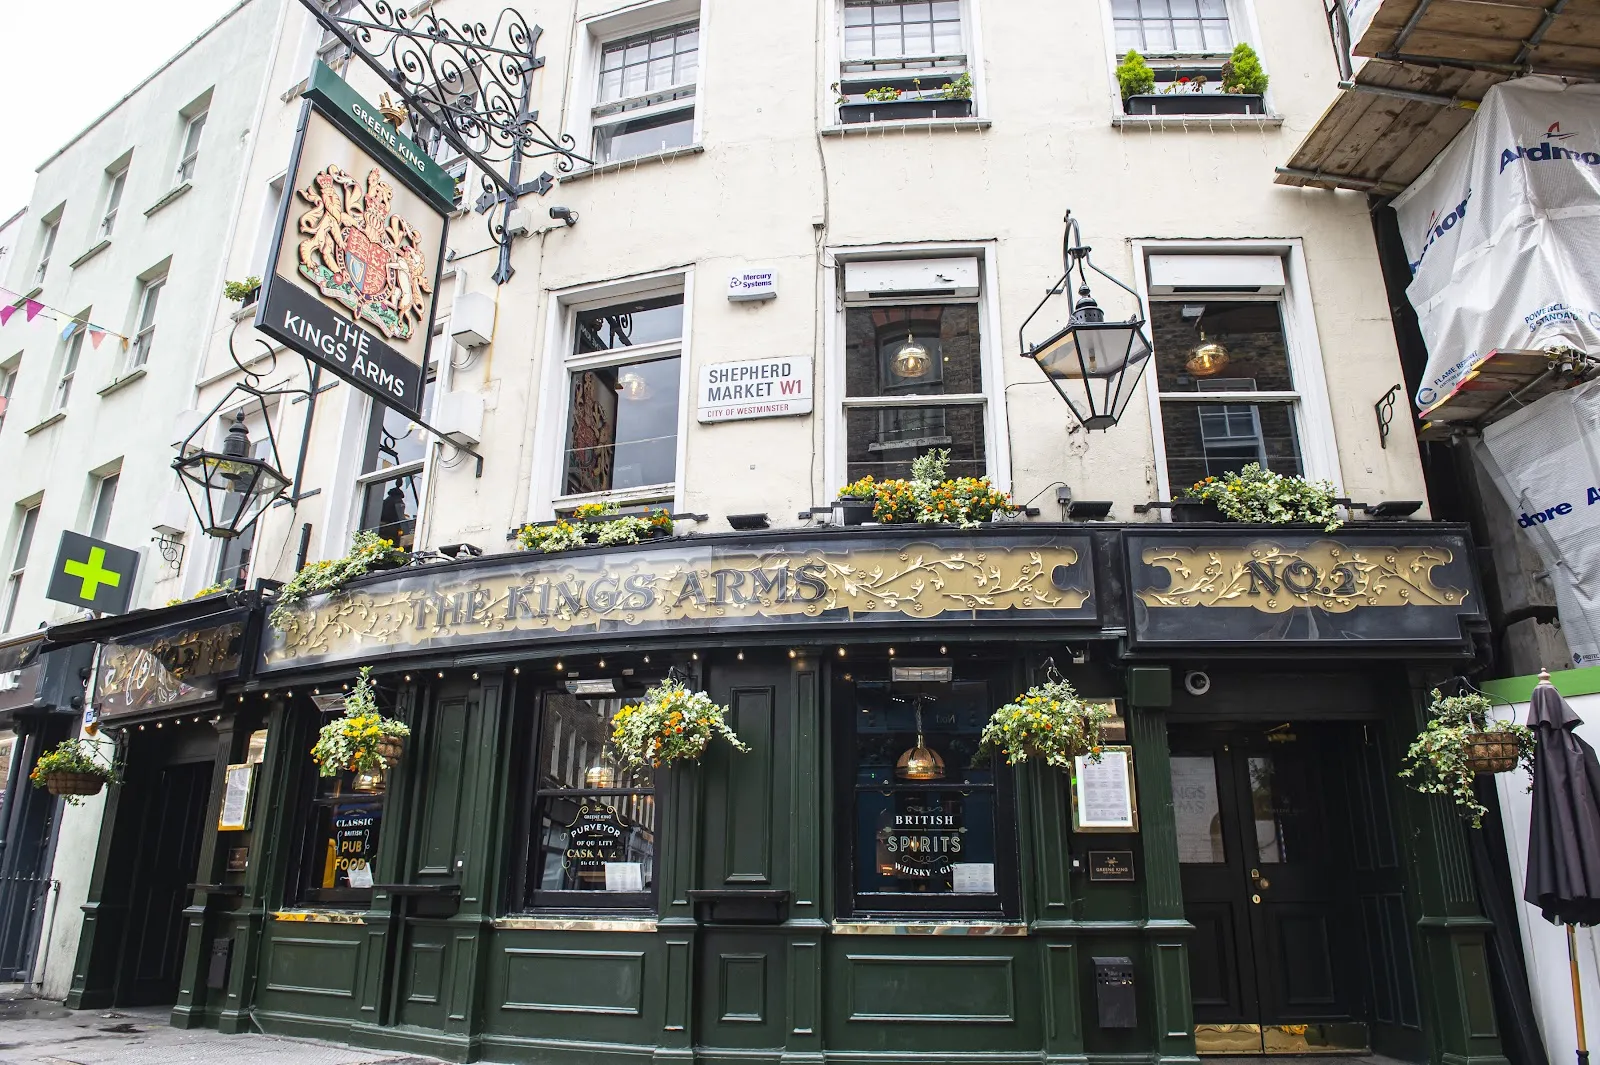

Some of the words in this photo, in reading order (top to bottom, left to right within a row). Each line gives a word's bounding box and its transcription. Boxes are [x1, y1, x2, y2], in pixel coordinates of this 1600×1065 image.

[352, 104, 396, 147] GREENE
[398, 142, 426, 172] KING
[743, 280, 772, 288] Systems
[333, 316, 371, 355] THE
[283, 310, 349, 363] KINGS
[351, 355, 405, 397] ARMS
[708, 362, 791, 384] SHEPHERD
[1433, 366, 1457, 386] FLAME
[708, 382, 774, 401] MARKET
[780, 379, 801, 395] W1
[707, 410, 723, 418] CITY
[726, 408, 735, 416] OF
[737, 404, 789, 415] WESTMINSTER
[411, 587, 491, 630] THE
[507, 573, 656, 621] KINGS
[673, 564, 827, 608] ARMS
[336, 818, 373, 828] CLASSIC
[895, 815, 953, 825] BRITISH
[570, 823, 621, 838] PURVEYOR
[341, 840, 362, 853] PUB
[887, 836, 961, 853] SPIRITS
[567, 849, 594, 858] CASK
[334, 857, 366, 870] FOOD
[895, 862, 932, 877] WHISKY
[940, 862, 958, 875] GIN
